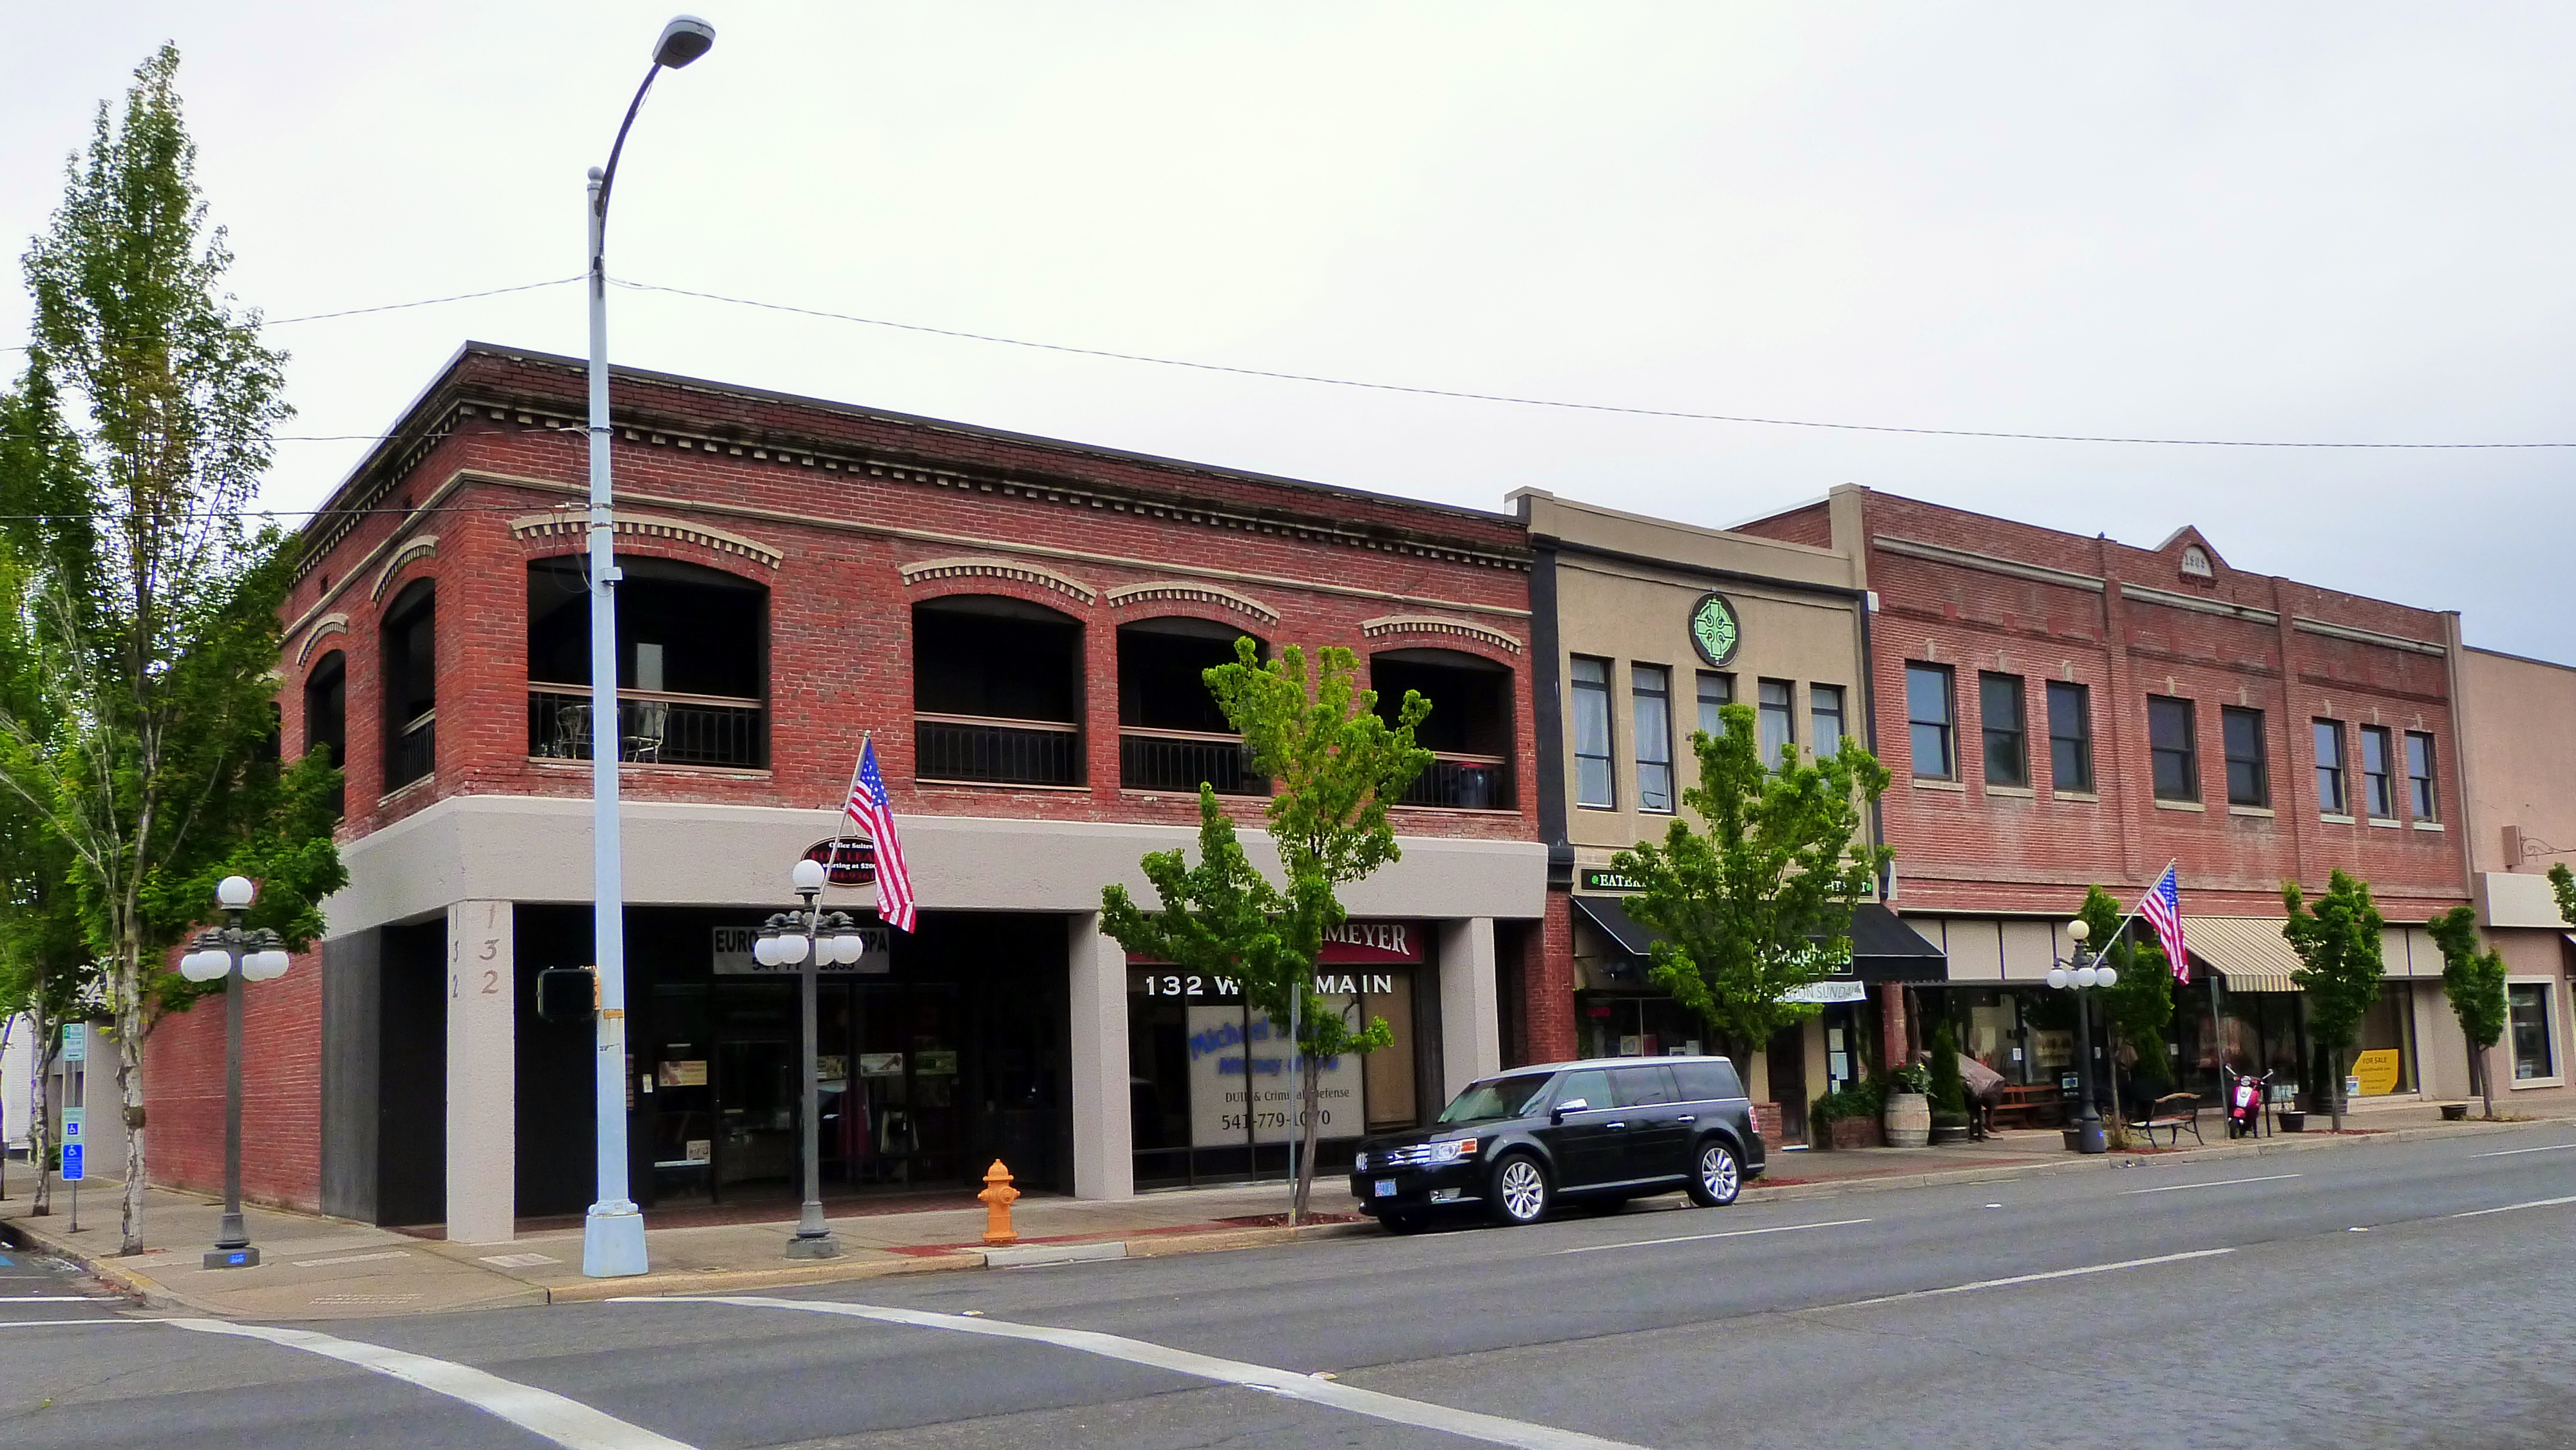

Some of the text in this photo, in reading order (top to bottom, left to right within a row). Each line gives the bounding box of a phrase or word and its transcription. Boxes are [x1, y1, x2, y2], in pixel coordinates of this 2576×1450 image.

[847, 852, 875, 862] LEA
[715, 930, 760, 952] EURO
[1321, 924, 1410, 956] MEYER
[1146, 976, 1203, 995] 132
[1316, 975, 1392, 993] MAIN
[1264, 1088, 1305, 1100] Crimial
[1318, 1086, 1350, 1098] efense
[1222, 1110, 1331, 1130] 541-779-100
